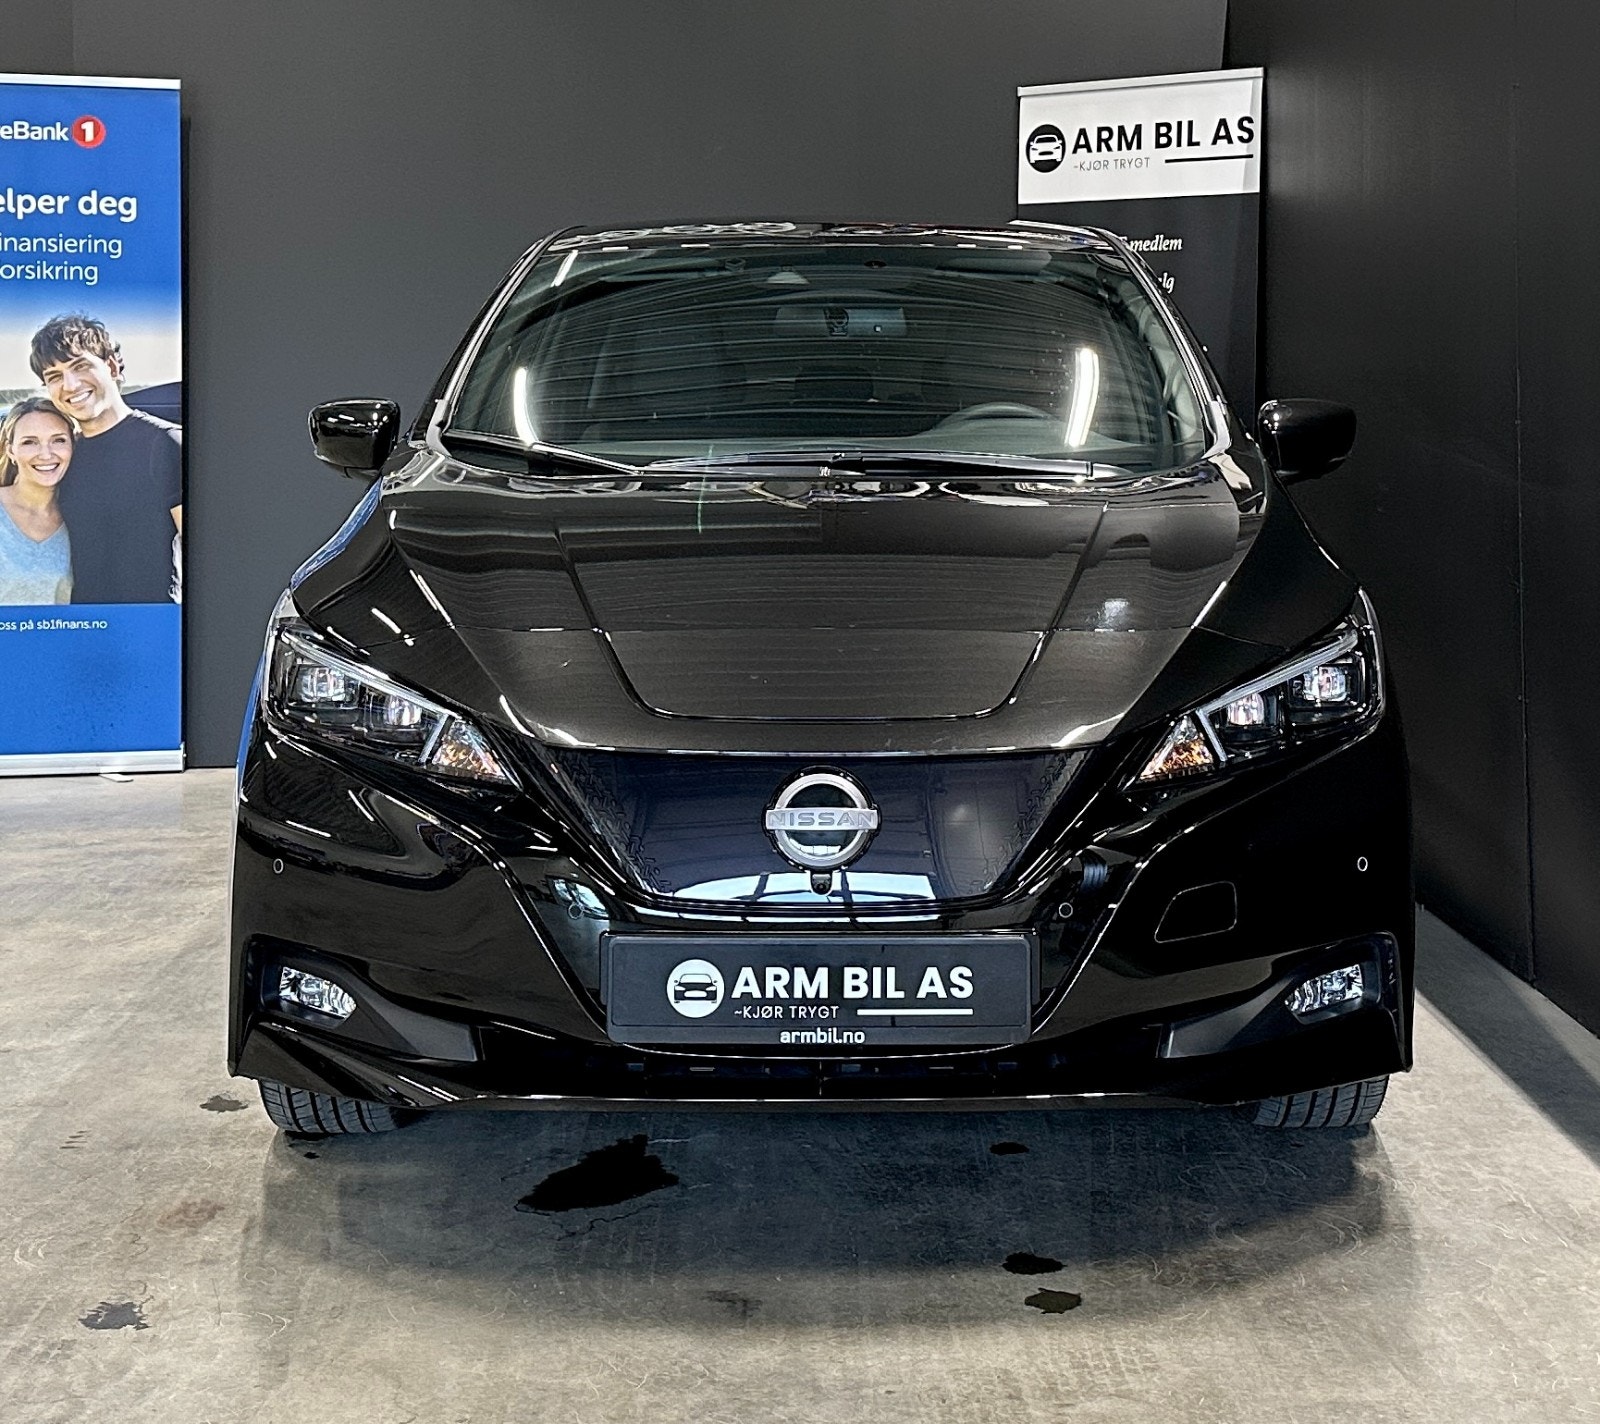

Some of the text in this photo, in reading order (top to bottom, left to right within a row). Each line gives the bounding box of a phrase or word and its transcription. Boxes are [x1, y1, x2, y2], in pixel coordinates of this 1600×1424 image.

[81, 121, 95, 142] 1
[1072, 116, 1255, 154] ARM BIL AS
[1114, 157, 1150, 170] TRYGT
[78, 190, 137, 222] deg
[0, 260, 98, 286] orsikring
[20, 619, 34, 632] på
[36, 618, 108, 630] sb1finans.no
[769, 811, 876, 828] NISSAN
[731, 966, 974, 999] ARM BIL AS
[789, 1005, 839, 1020] TRYGT
[779, 1027, 866, 1045] armbil.no
